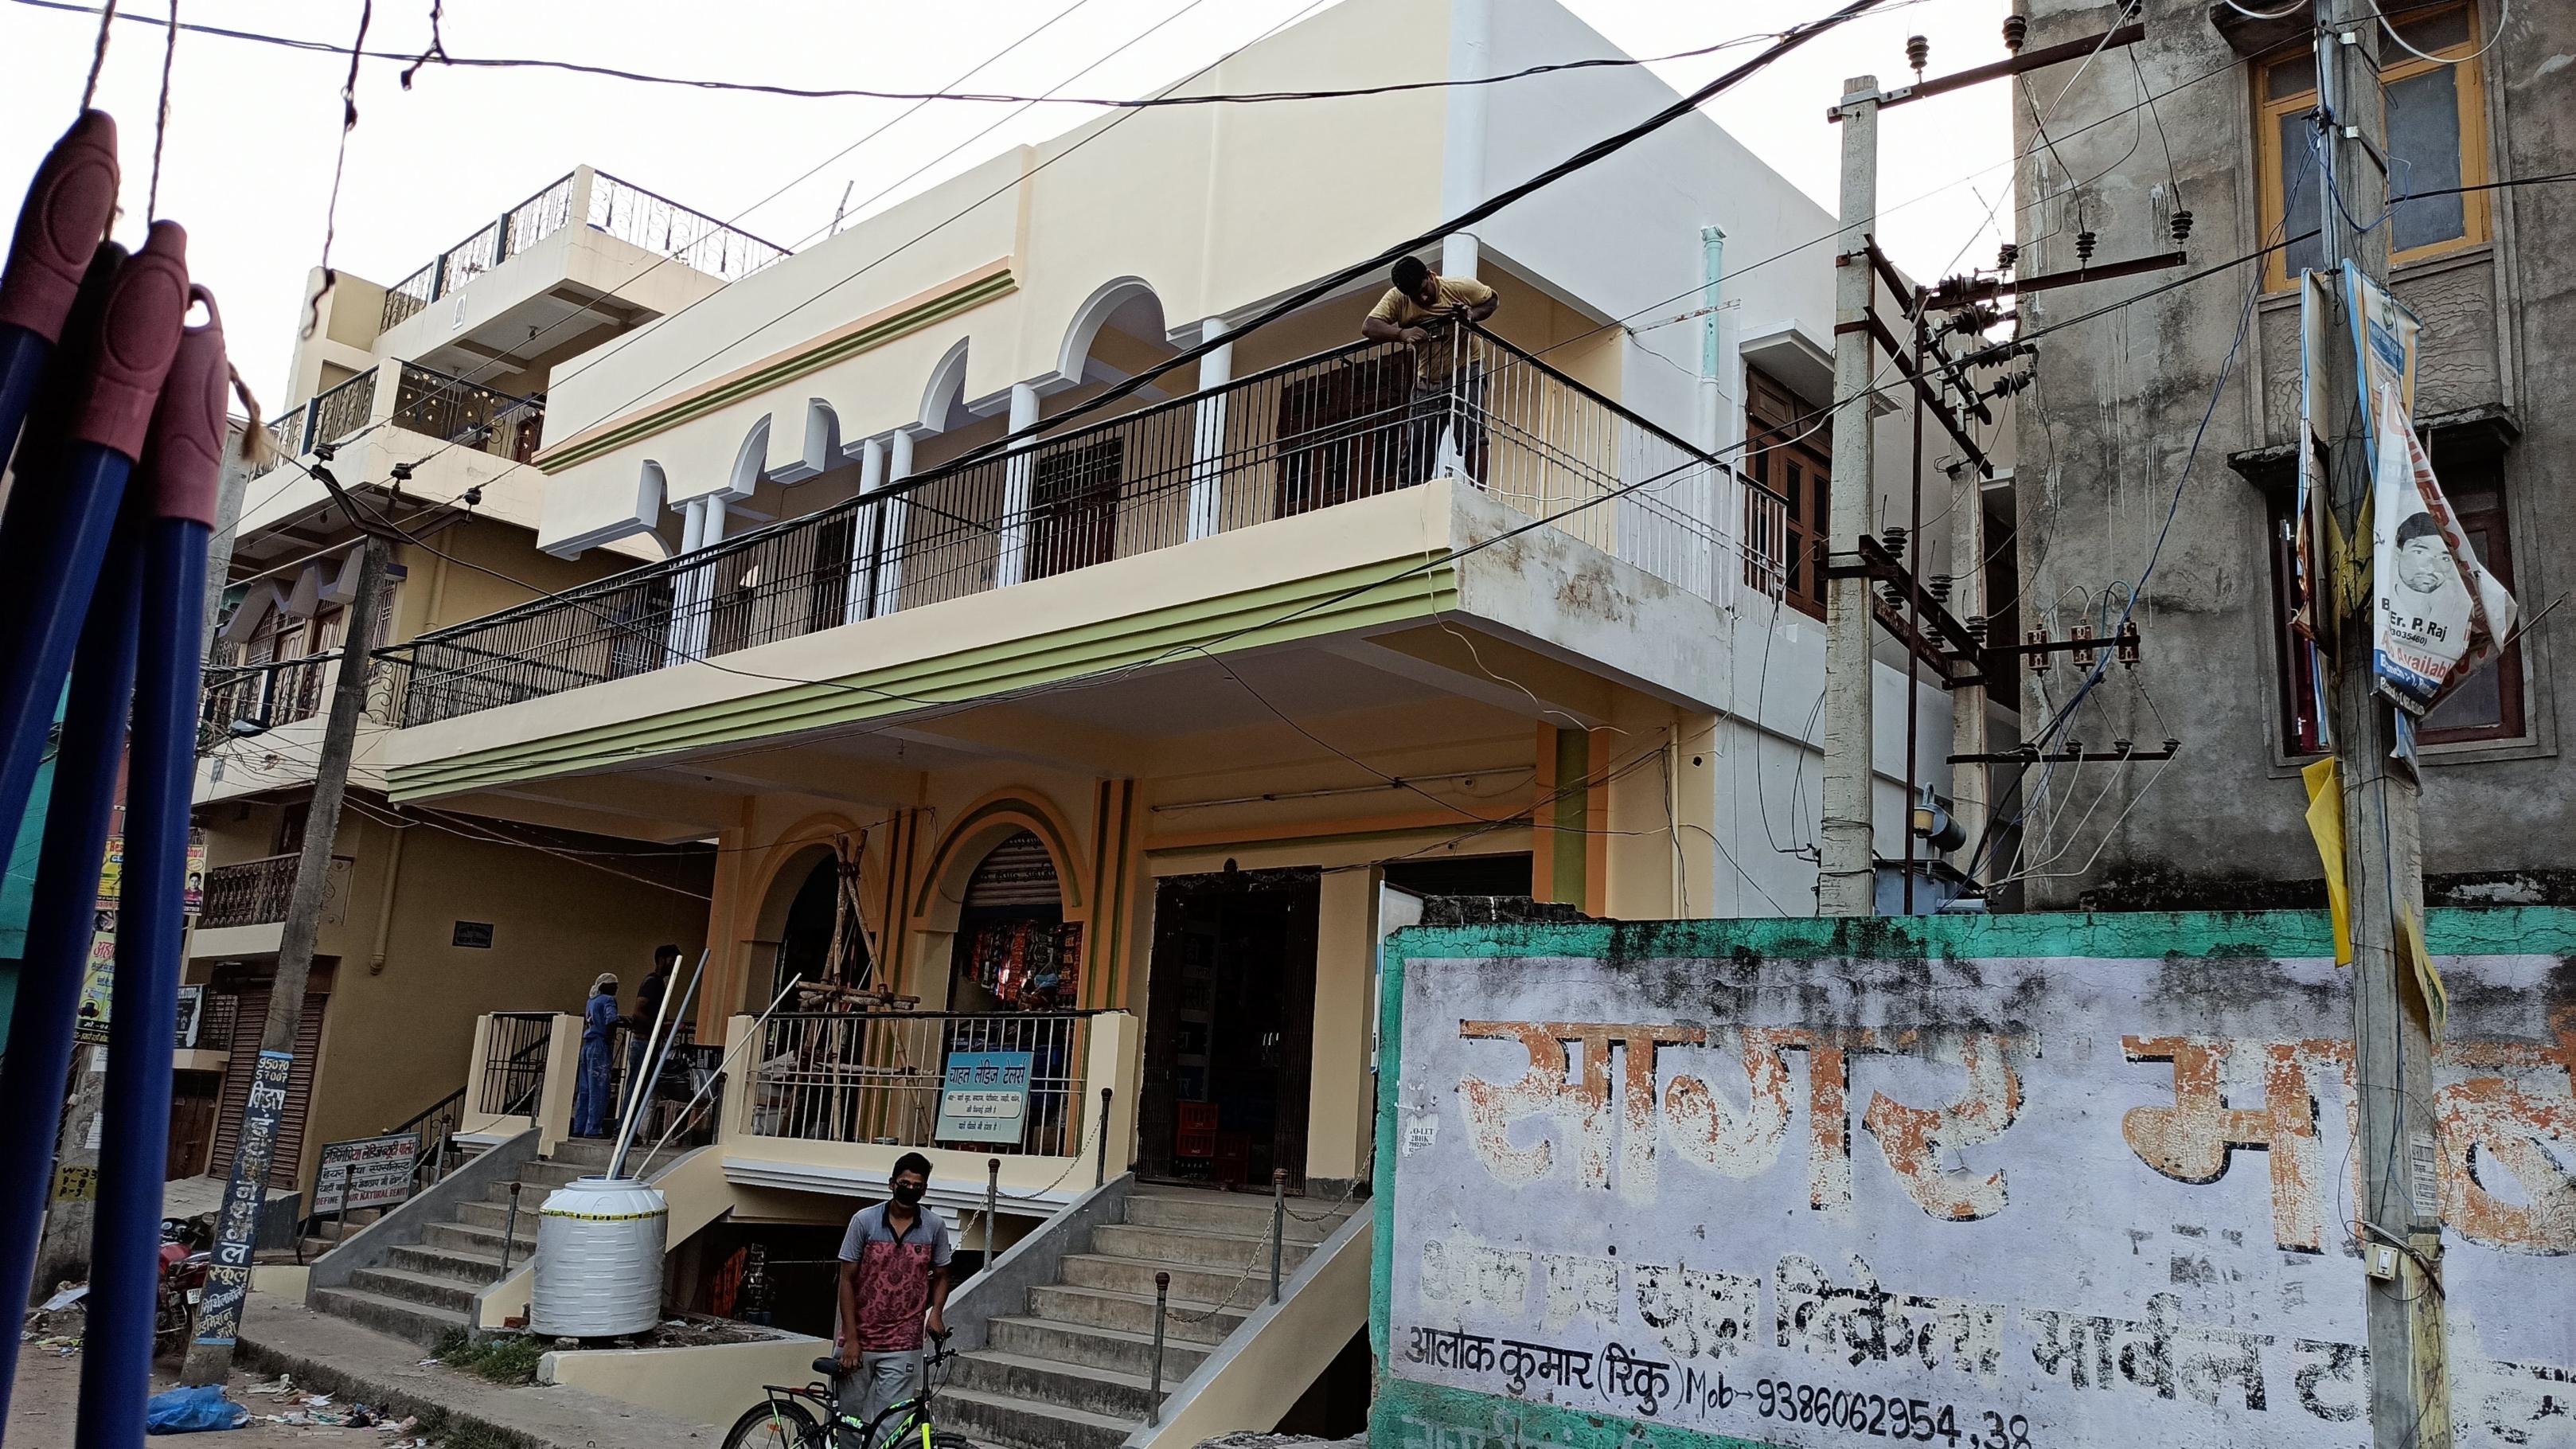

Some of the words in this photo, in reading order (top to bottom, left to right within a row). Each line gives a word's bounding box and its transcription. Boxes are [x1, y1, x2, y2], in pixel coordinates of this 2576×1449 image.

[2390, 611, 2406, 628] Er.
[2411, 617, 2423, 632] P.
[2426, 621, 2447, 642] Raj
[2391, 628, 2427, 646] 3035460)
[2397, 647, 2452, 679] Availabl
[258, 1057, 290, 1072] 95070
[256, 1070, 288, 1084] 57007
[949, 1066, 971, 1084] चाहत
[1453, 1017, 2038, 1224] सागर
[315, 1196, 338, 1205] DEFINE
[359, 1189, 388, 1201] NATURAL
[1404, 1325, 1495, 1369] आलोक
[1500, 1338, 1594, 1395] कुमार
